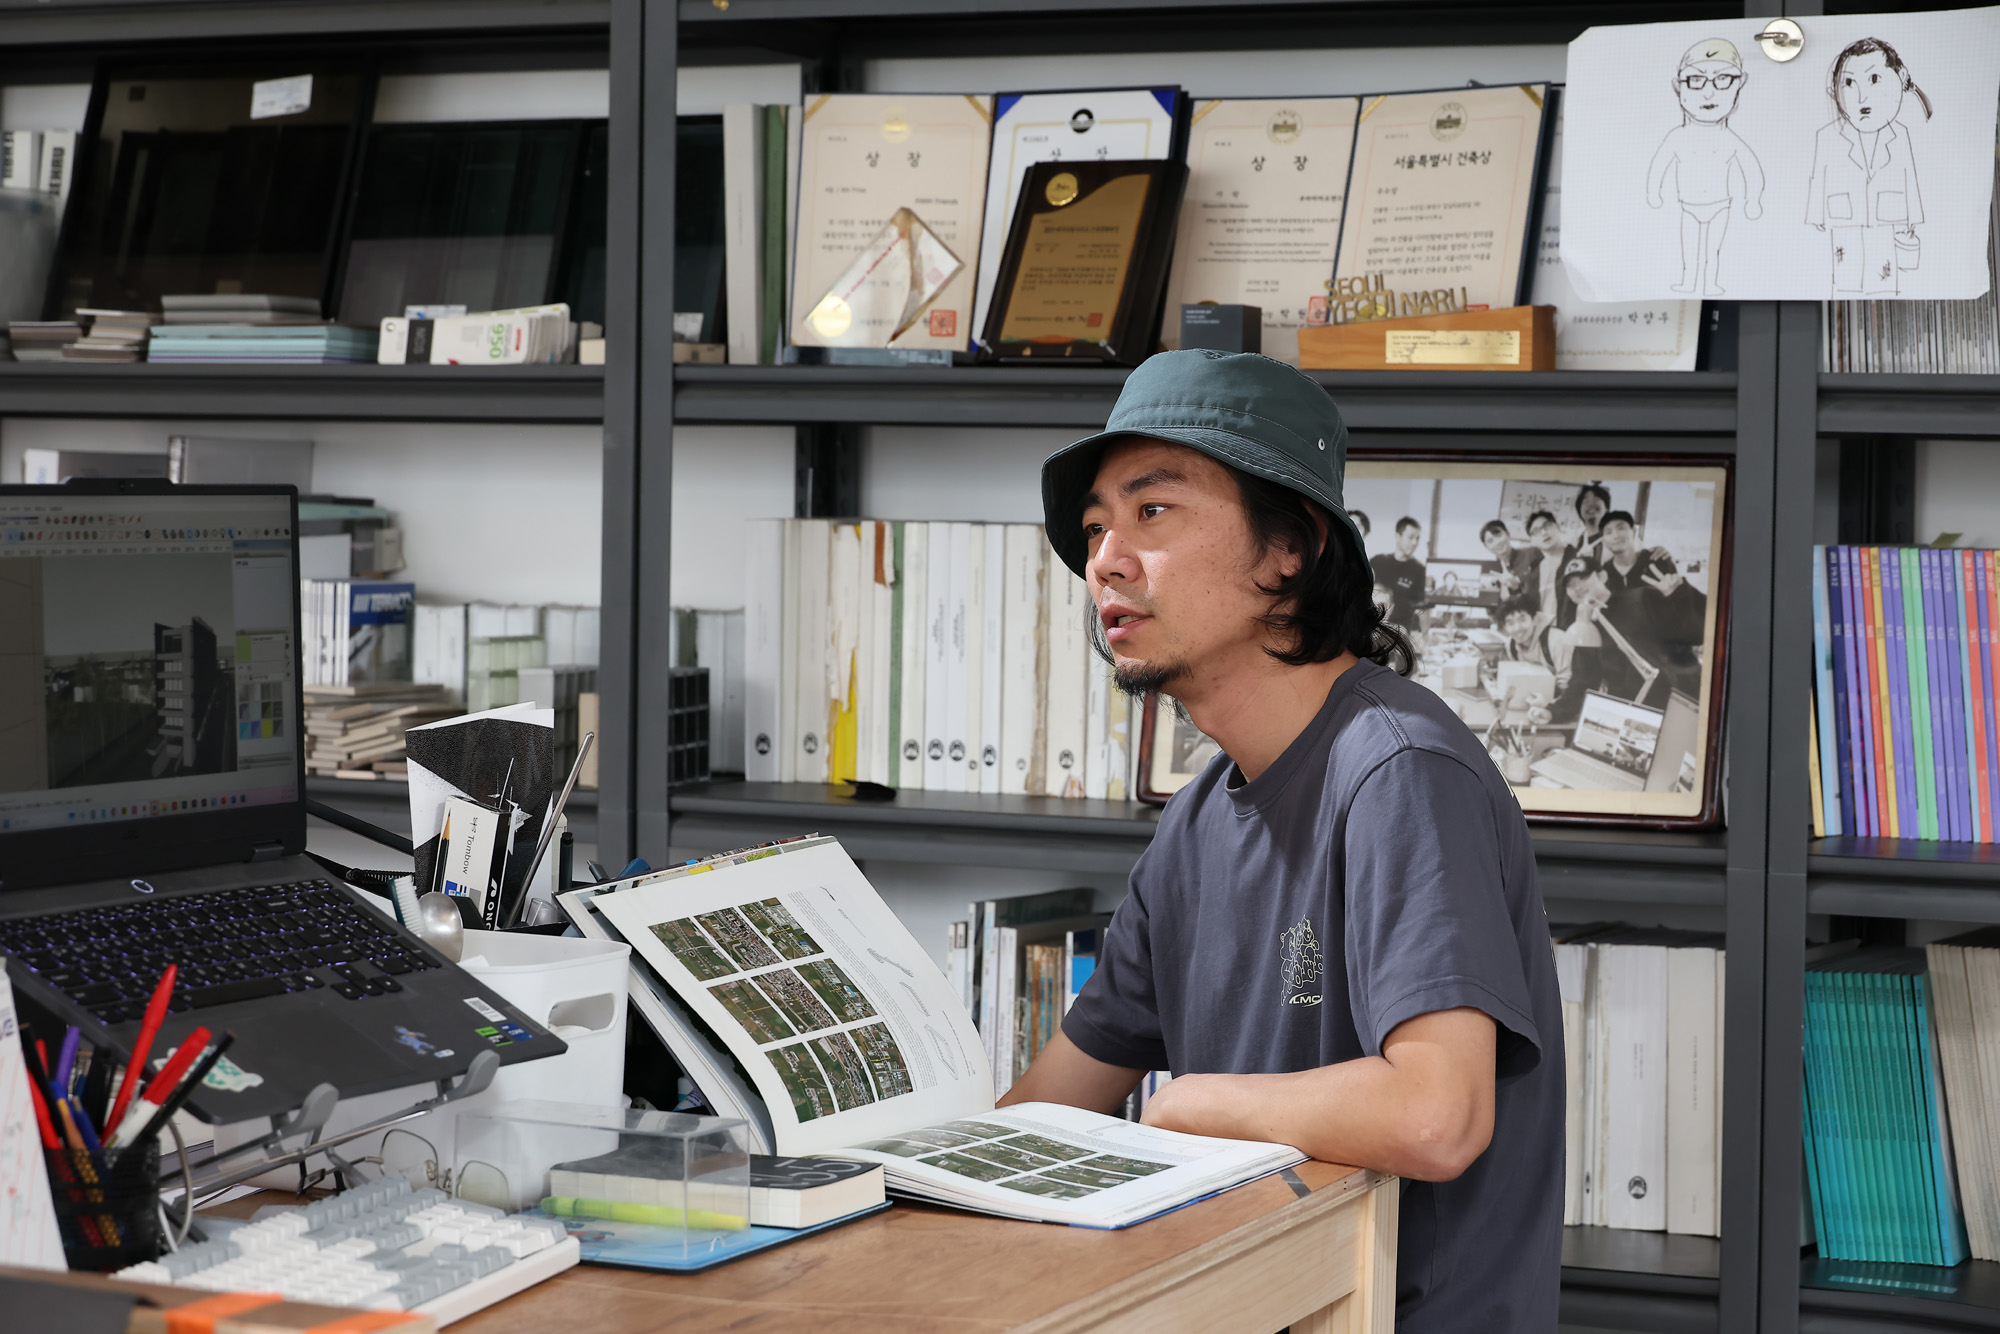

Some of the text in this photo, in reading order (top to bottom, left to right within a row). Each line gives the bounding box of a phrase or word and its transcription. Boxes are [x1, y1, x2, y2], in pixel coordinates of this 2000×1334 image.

[866, 152, 921, 168] 상 장
[1251, 155, 1308, 172] 상 장
[1394, 149, 1491, 169] 서울특별시 건축상
[1324, 274, 1389, 299] SEOUL
[1401, 287, 1467, 316] NARU
[489, 323, 505, 359] 950
[462, 834, 475, 875] Tombow
